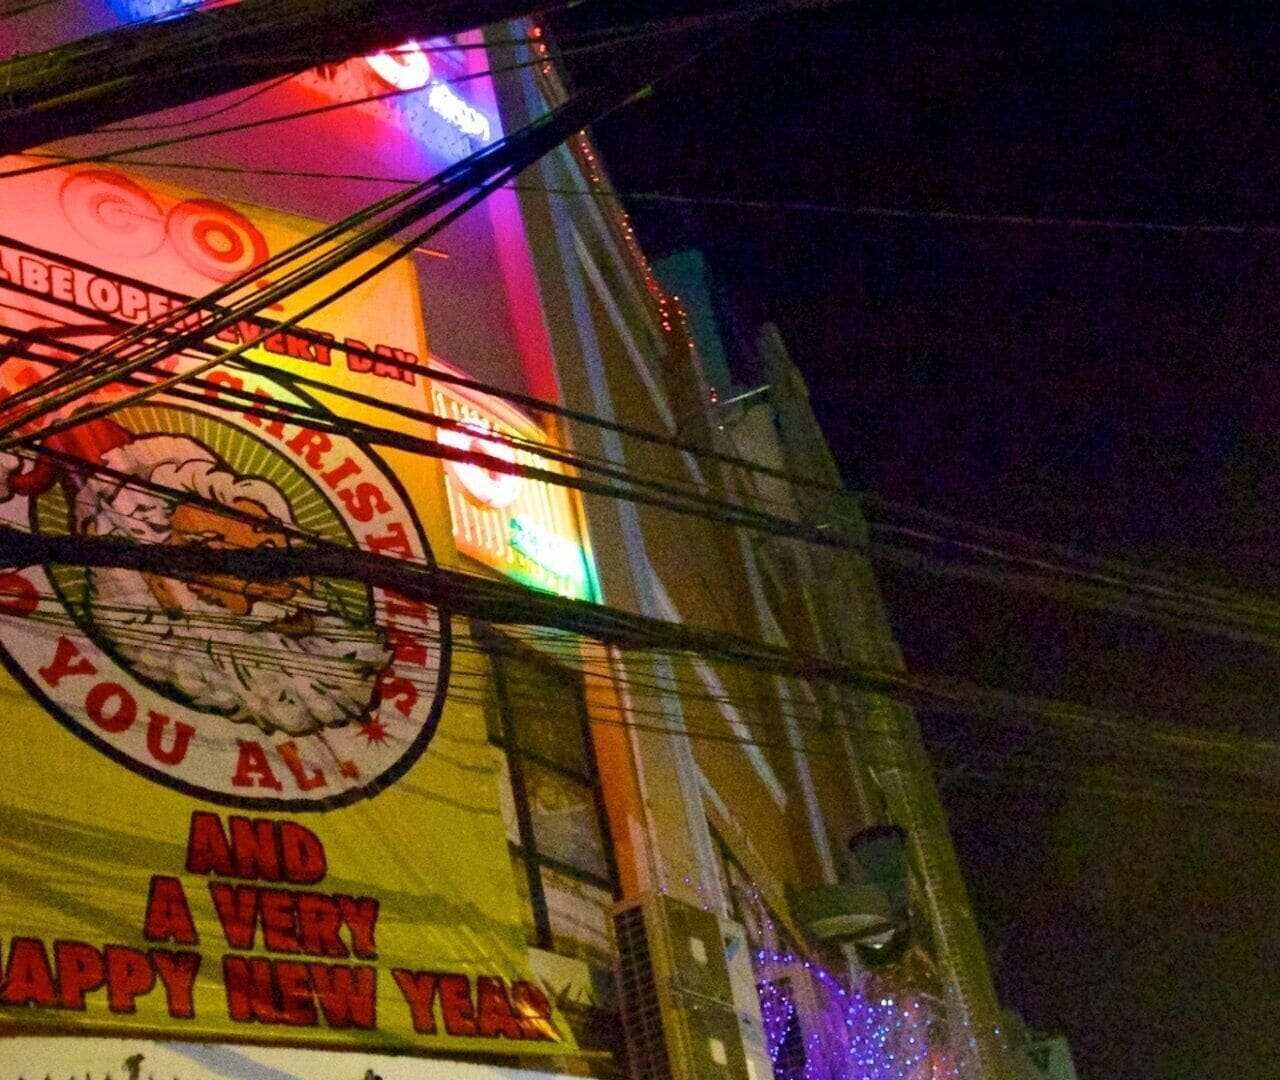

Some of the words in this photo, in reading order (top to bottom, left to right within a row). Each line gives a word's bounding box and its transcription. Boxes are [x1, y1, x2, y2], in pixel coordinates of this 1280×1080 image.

[18, 255, 80, 306] BE
[345, 338, 419, 387] DAY
[39, 636, 196, 766] YOU
[185, 811, 329, 885] AND
[144, 875, 198, 945] A
[209, 881, 380, 960] VERY
[223, 954, 379, 1030] NEW
[391, 968, 556, 1043] YEAR
